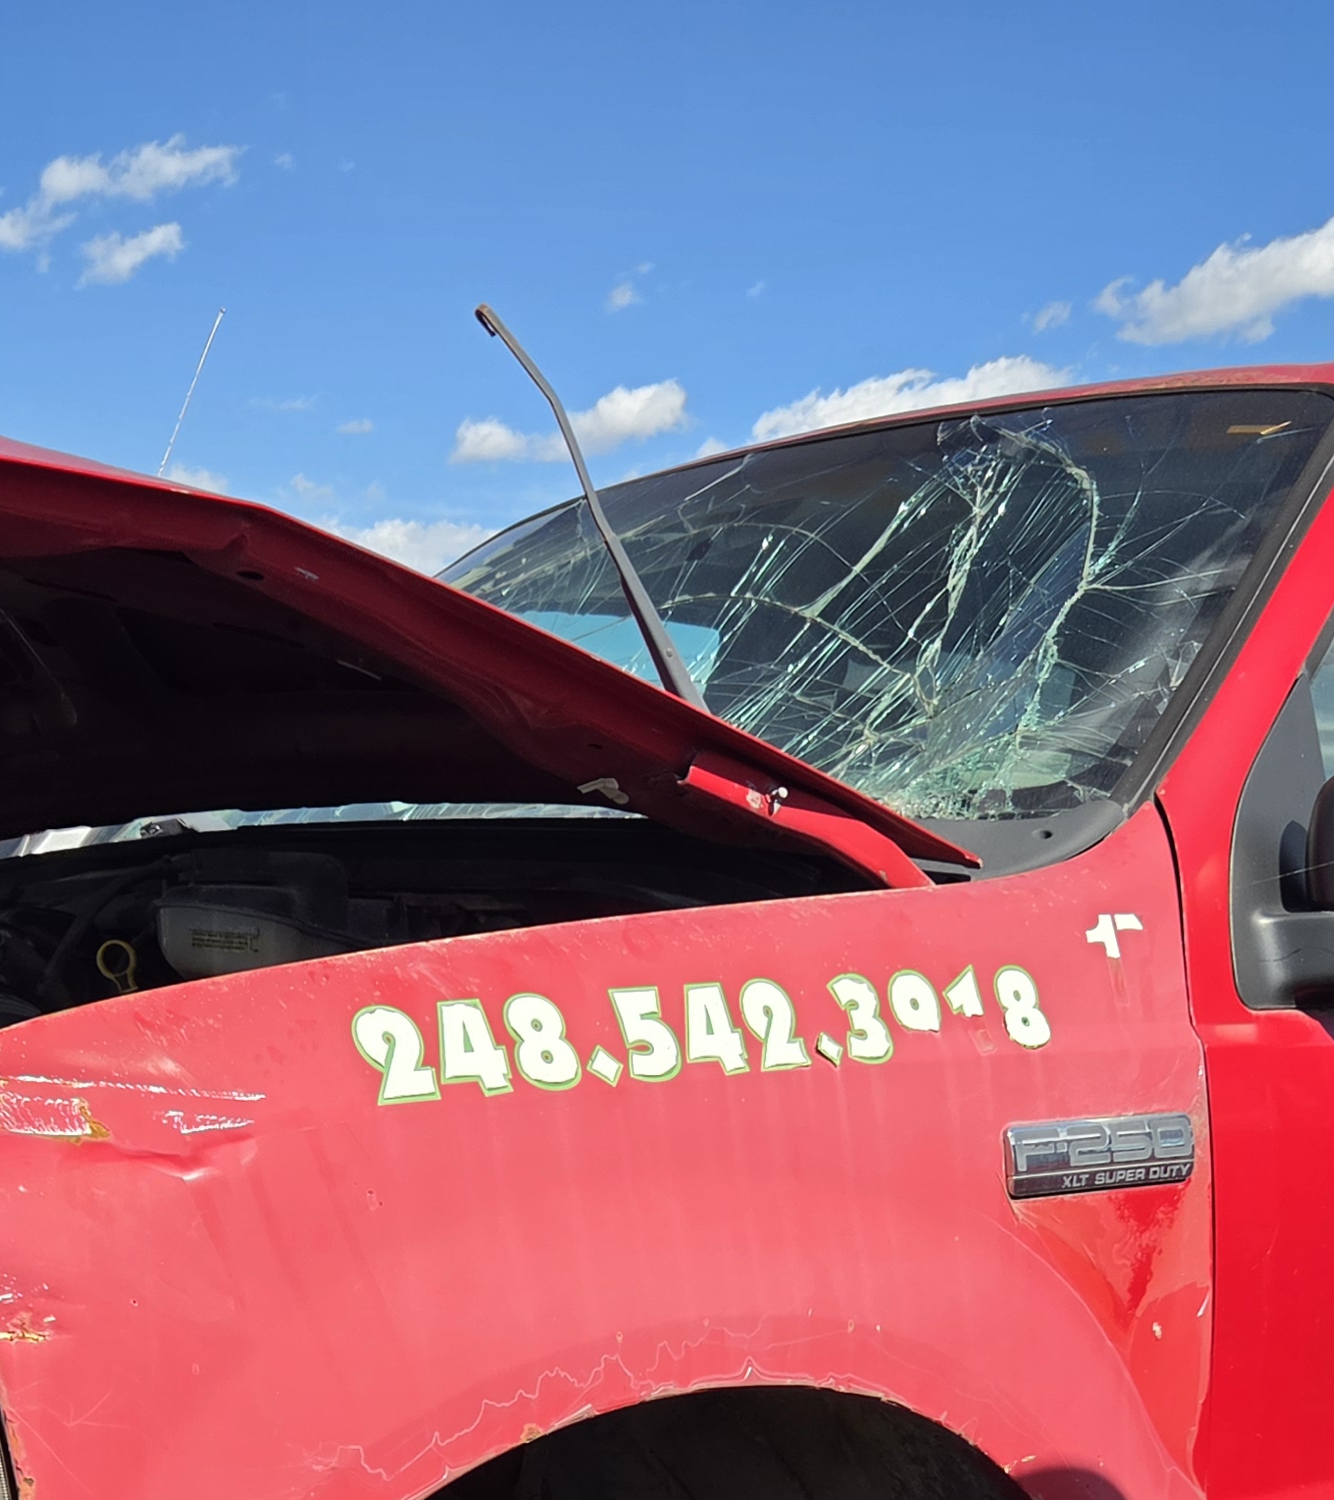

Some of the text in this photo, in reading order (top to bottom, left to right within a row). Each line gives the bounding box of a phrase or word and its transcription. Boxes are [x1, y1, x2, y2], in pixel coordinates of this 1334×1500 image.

[1061, 1163, 1191, 1188] XLT SUPER DUTY
